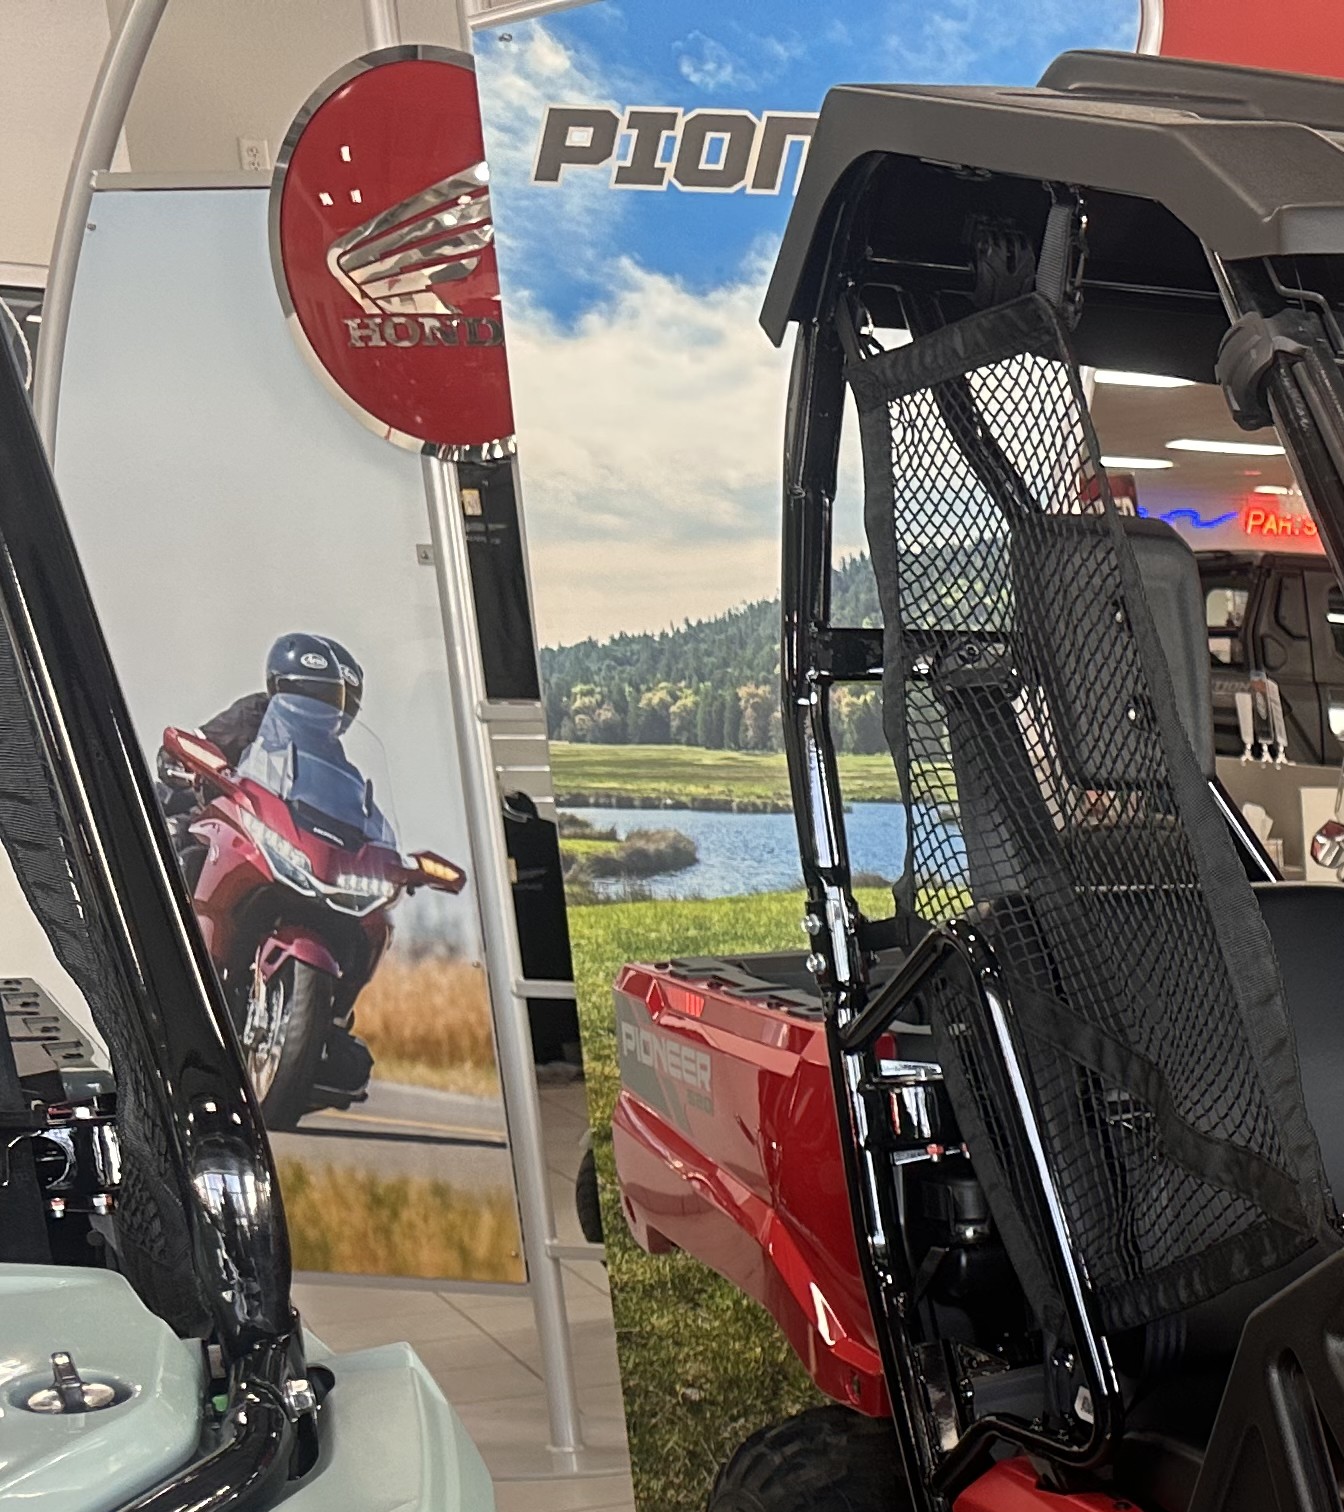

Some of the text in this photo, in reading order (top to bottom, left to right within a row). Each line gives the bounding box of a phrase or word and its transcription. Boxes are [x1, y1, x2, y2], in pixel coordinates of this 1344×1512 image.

[531, 103, 820, 196] PION
[343, 316, 505, 347] HOND
[620, 1020, 713, 1093] PIONEER
